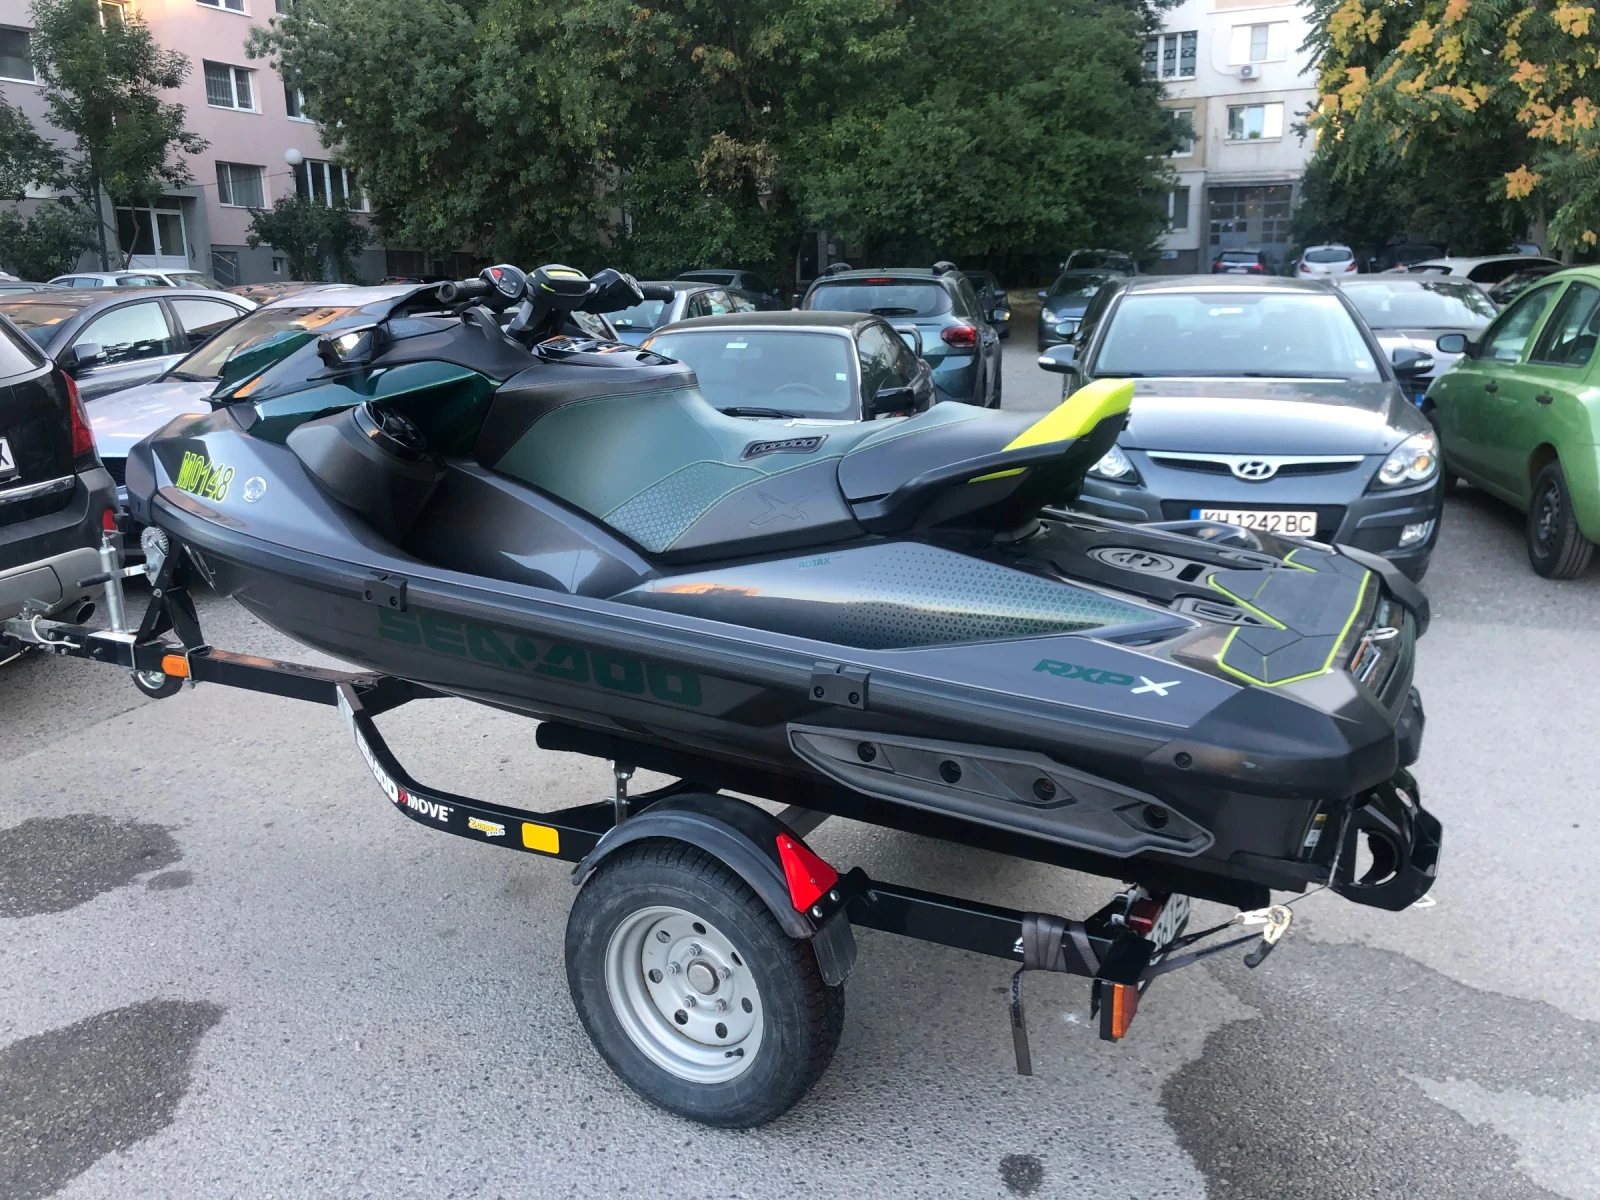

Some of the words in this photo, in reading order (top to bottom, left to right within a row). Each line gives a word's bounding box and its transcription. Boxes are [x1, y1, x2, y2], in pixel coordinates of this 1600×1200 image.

[1236, 513, 1281, 532] 1242
[1285, 515, 1312, 533] BC
[798, 557, 831, 569] ROTAX
[1032, 658, 1135, 686] RXP
[406, 794, 449, 822] MOVE
